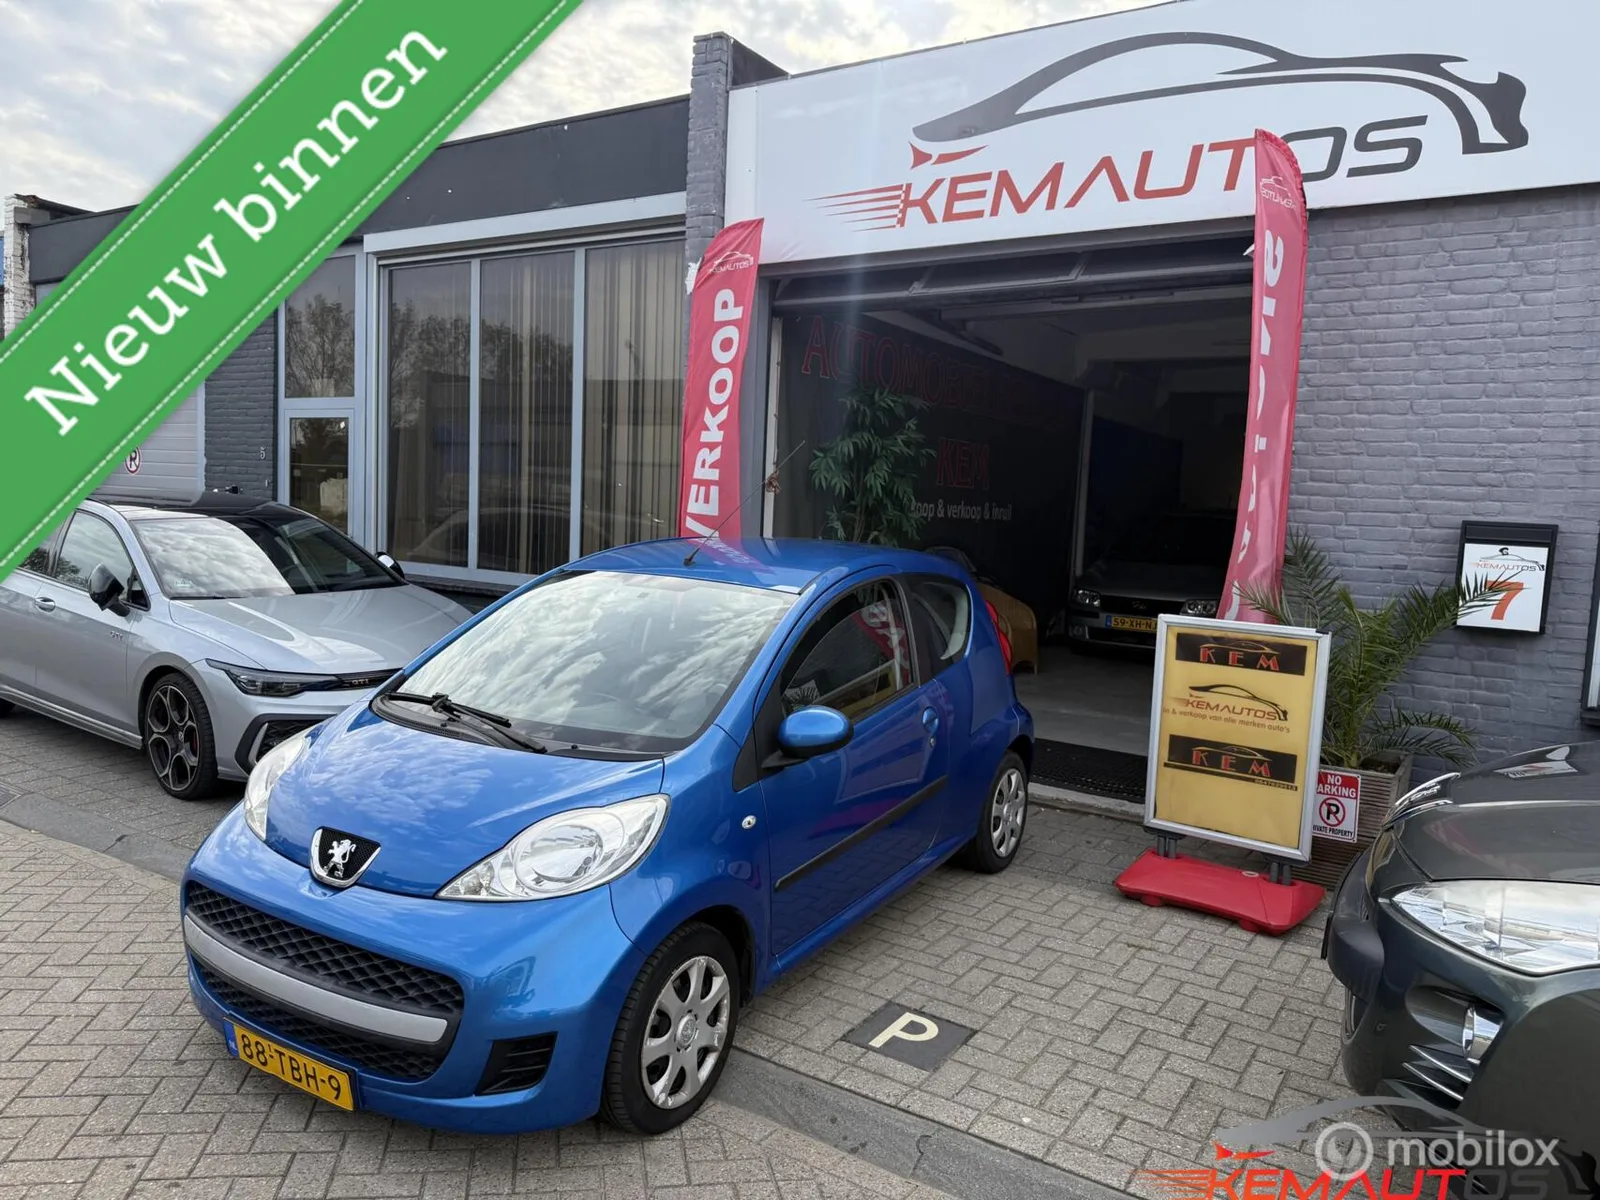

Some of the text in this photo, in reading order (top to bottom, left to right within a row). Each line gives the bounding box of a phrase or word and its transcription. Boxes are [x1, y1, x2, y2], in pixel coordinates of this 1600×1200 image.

[898, 114, 1428, 229] KEMAUTOS
[935, 436, 990, 491] KEM
[936, 499, 945, 518] &
[946, 501, 982, 523] verkoop
[1476, 562, 1537, 571] KEMAUTOS
[1482, 580, 1525, 621] 7
[1185, 699, 1278, 720] KEMAUTOS
[1238, 718, 1266, 729] merken
[1317, 783, 1356, 798] ARKING
[1327, 774, 1342, 786] NO
[1329, 827, 1354, 838] PROPERTY
[868, 1012, 939, 1048] P
[241, 1033, 341, 1101] 88-TBH-9
